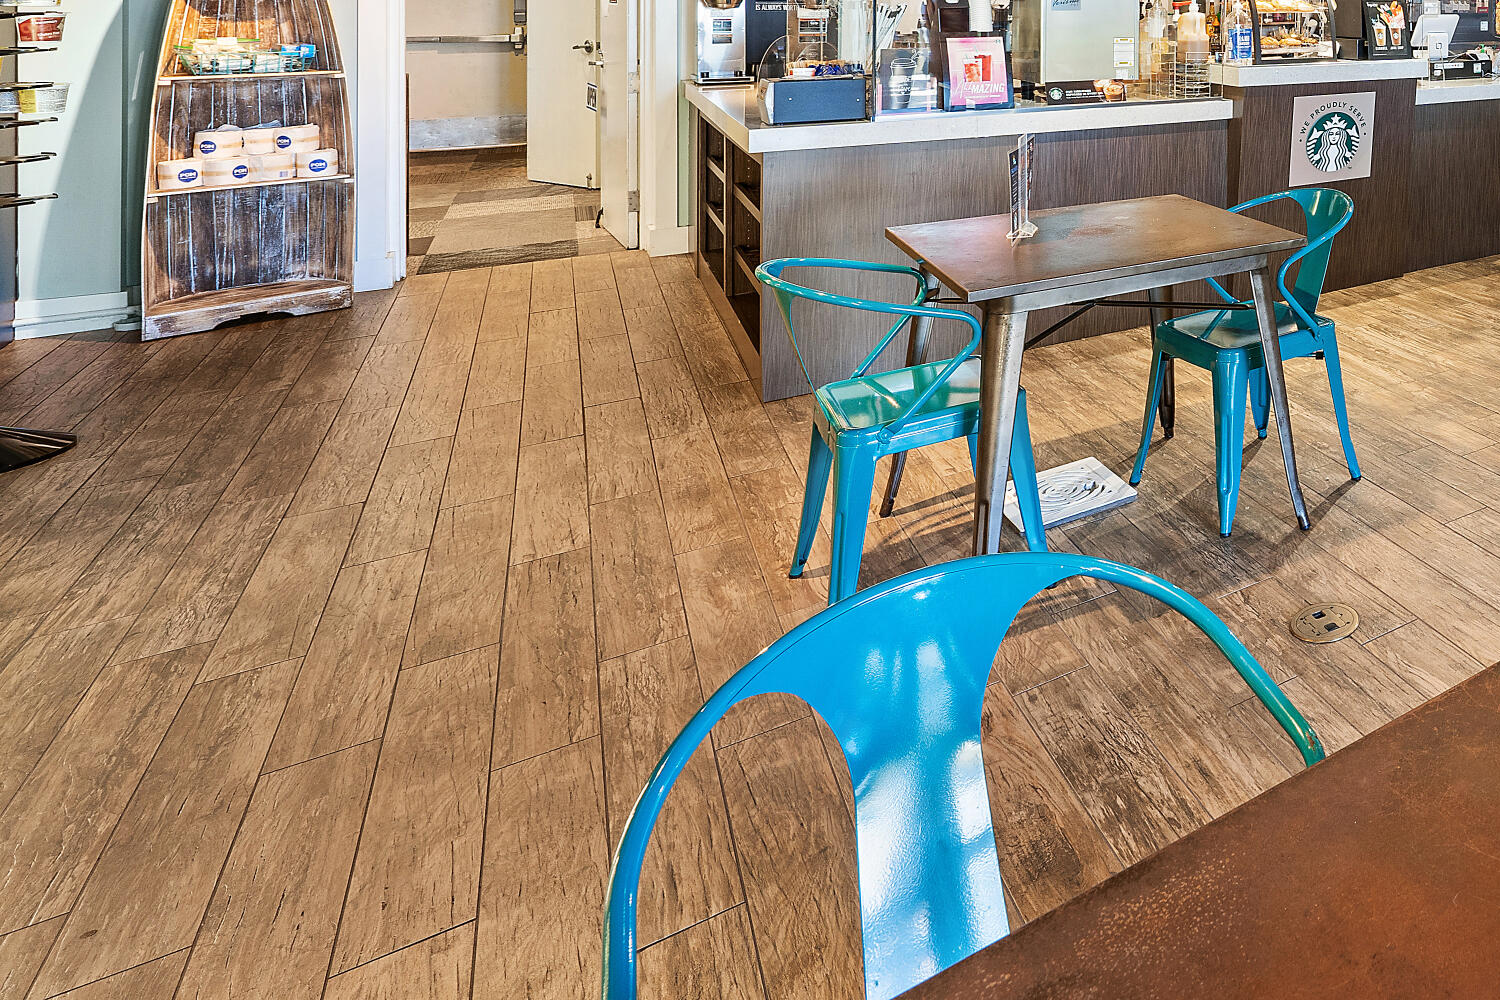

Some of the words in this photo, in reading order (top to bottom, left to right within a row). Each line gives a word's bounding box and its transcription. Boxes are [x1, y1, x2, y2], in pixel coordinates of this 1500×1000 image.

[1300, 122, 1311, 134] WE
[1310, 101, 1348, 119] PROUDLY
[1348, 105, 1366, 127] SERVE
